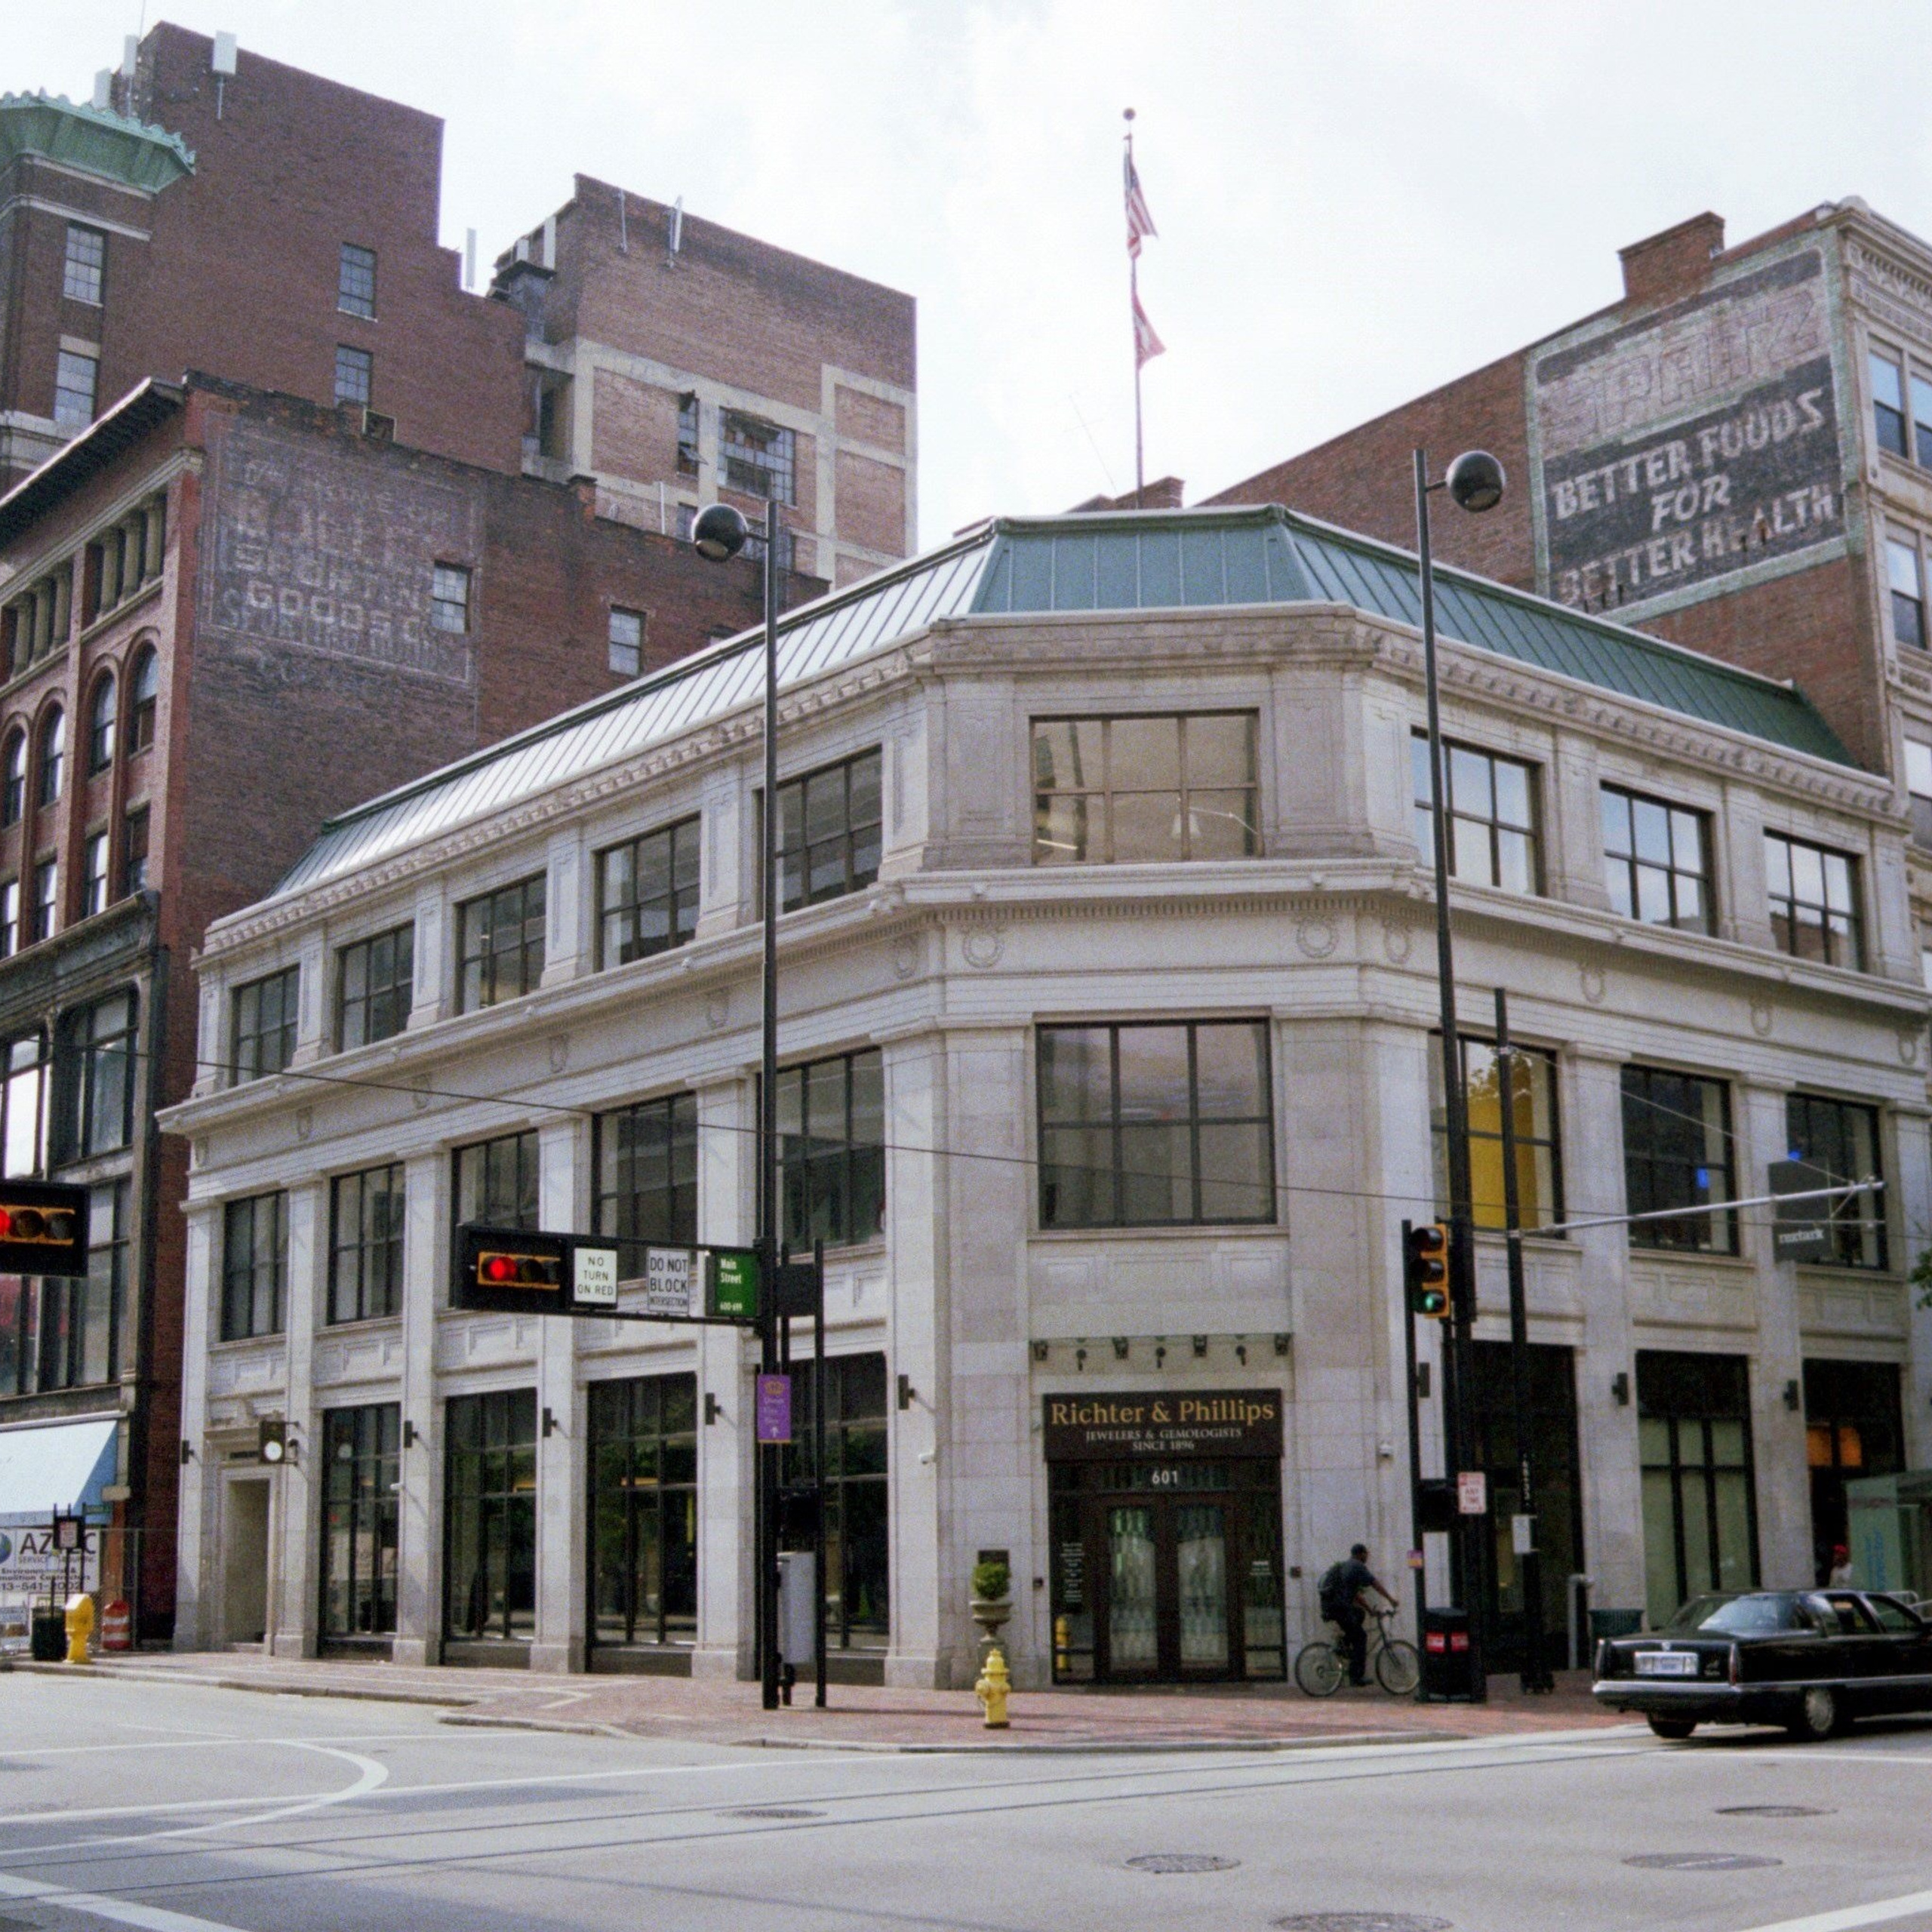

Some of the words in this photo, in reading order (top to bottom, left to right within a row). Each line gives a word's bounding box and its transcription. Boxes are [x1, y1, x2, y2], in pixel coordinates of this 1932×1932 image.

[1552, 439, 1694, 521] BETTER
[1650, 473, 1732, 534] FOR
[1558, 529, 1697, 607] BETTER
[1703, 483, 1835, 560] HEALTH
[245, 577, 392, 638] GOODS
[588, 1257, 605, 1266] NO
[651, 1257, 664, 1271] DO
[667, 1259, 688, 1272] NOT
[720, 1258, 737, 1269] Main
[584, 1269, 609, 1281] TURN
[720, 1272, 742, 1284] Street
[577, 1284, 591, 1294] ON
[595, 1285, 614, 1296] RED
[650, 1277, 688, 1294] BLOCK
[1051, 1402, 1144, 1425] Richter
[1151, 1400, 1171, 1423] &
[1179, 1399, 1275, 1426] Phillips
[1086, 1430, 1141, 1442] JEWELERS
[1146, 1430, 1154, 1439] &
[1159, 1428, 1242, 1440] GEMOLOGISTS
[1132, 1440, 1165, 1451] SINCE
[1170, 1439, 1195, 1451] 1896
[1152, 1469, 1179, 1485] 601
[20, 1532, 97, 1555] AZC
